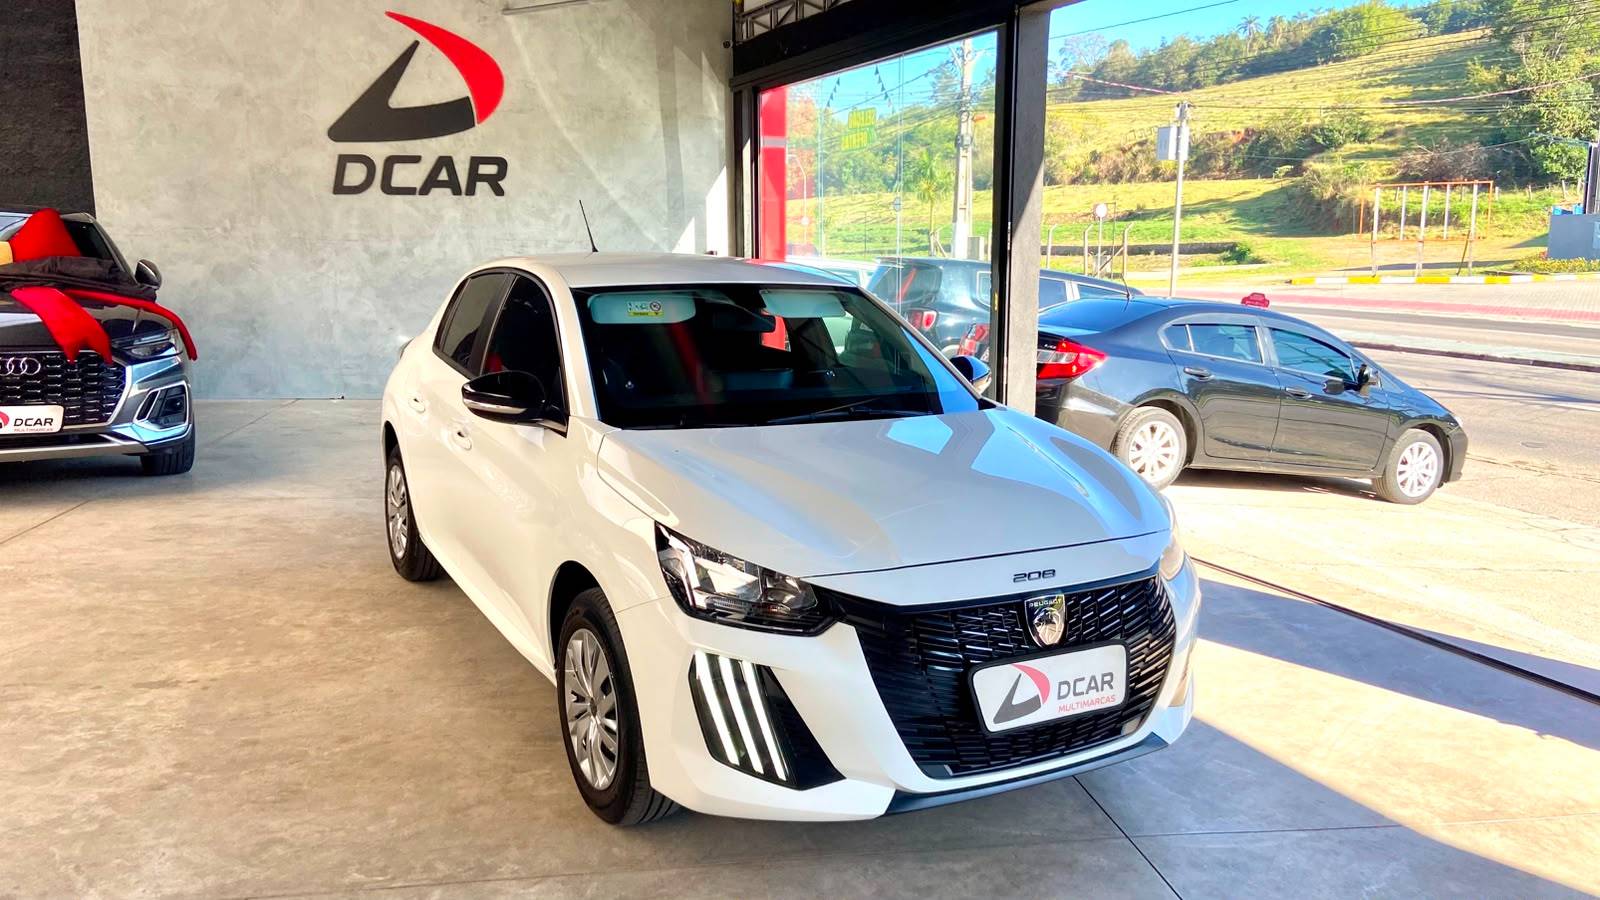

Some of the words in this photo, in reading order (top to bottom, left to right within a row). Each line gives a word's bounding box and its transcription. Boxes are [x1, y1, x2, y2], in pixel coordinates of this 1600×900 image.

[332, 154, 508, 196] DCAR
[13, 417, 54, 427] DCAR
[1013, 569, 1056, 583] 208
[1057, 672, 1114, 700] DCAR
[1058, 695, 1117, 713] MULTIMARCAS
